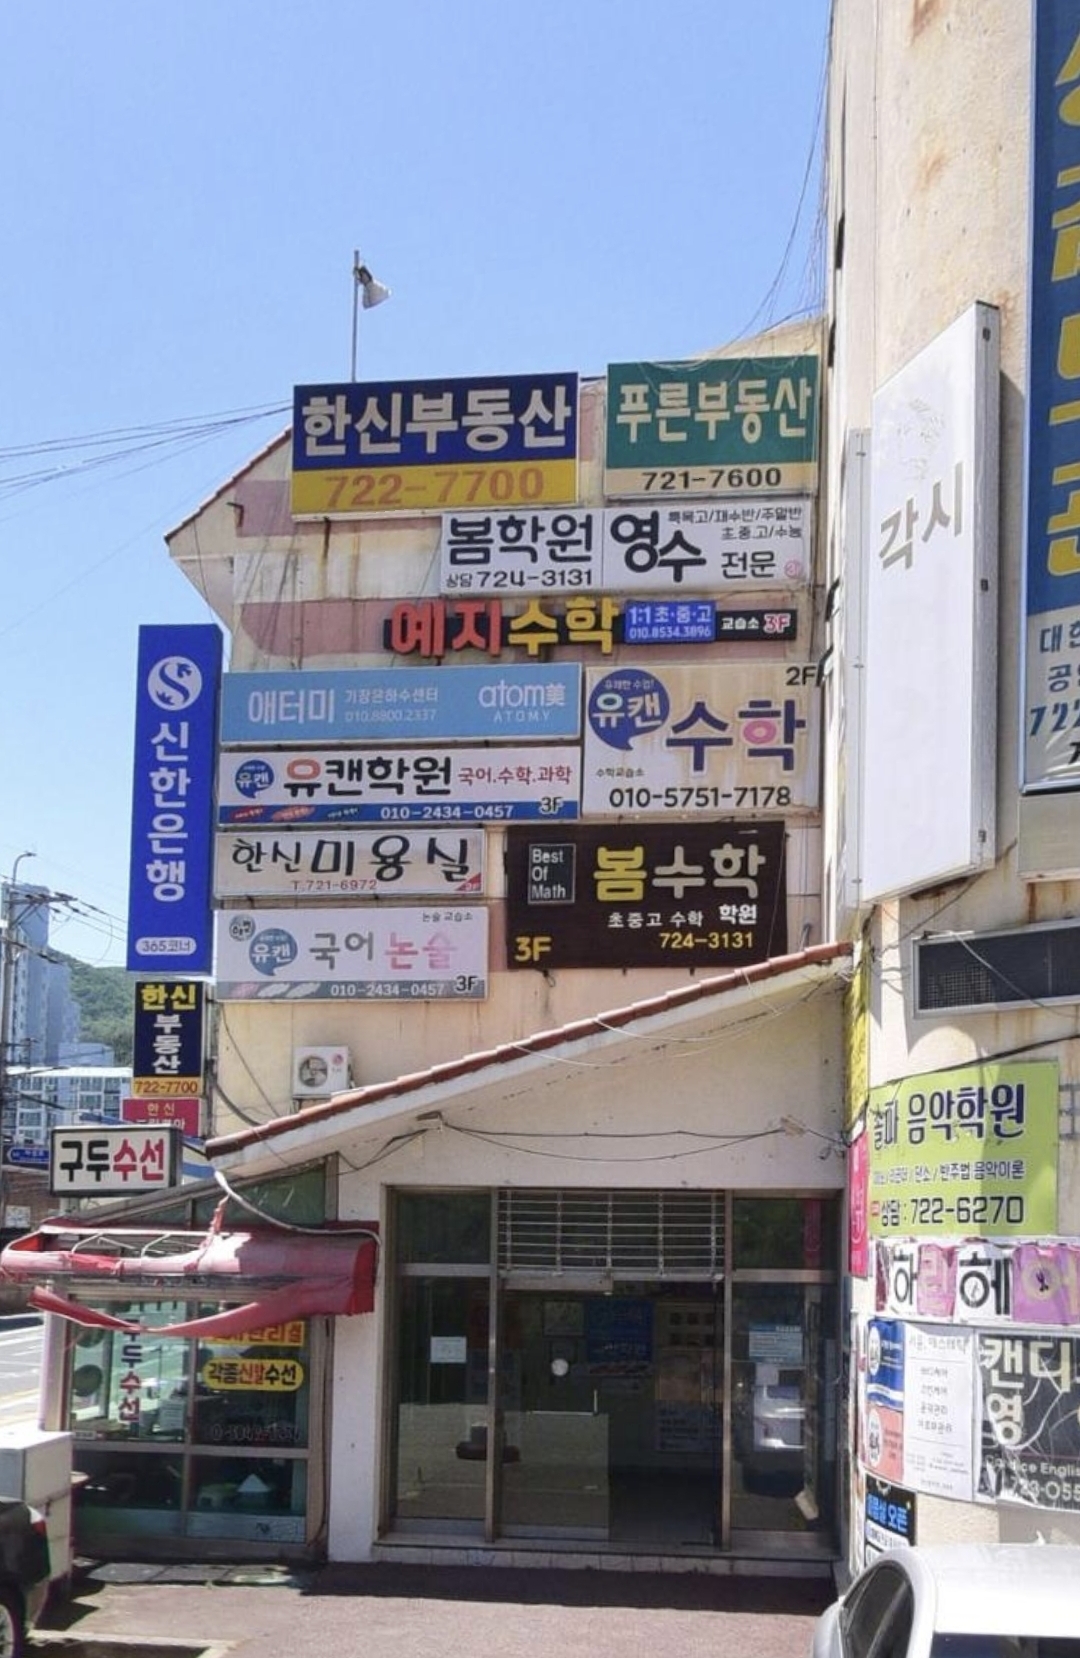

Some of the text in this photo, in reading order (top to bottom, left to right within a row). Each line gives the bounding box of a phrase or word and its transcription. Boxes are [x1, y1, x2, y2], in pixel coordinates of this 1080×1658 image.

[302, 383, 571, 458] 한신부동산
[616, 377, 812, 444] 푸른부동산
[325, 468, 544, 507] 722-7700
[642, 467, 782, 491] 721-7600
[879, 461, 964, 570] 각시
[447, 512, 593, 565] 봄학원
[610, 510, 707, 583] 영수
[721, 551, 776, 579] 전문
[446, 568, 593, 589] 상담 724-3131
[391, 598, 618, 657] 예지수학
[628, 606, 651, 625] 1:1
[721, 613, 792, 634] 교습소 3F
[786, 666, 817, 686] 2F
[249, 688, 335, 725] 애터미
[493, 710, 550, 723] ATOMY
[591, 692, 663, 729] 유캔
[665, 699, 806, 772] 수학
[283, 756, 451, 799] 유캔학원
[458, 765, 573, 786] 국어.수학.과학
[538, 797, 563, 815] 3F
[609, 785, 792, 808] 010-5751-7178
[146, 720, 192, 902] 신한은행
[380, 805, 514, 821] 010-2434-0457
[531, 849, 565, 864] Best
[531, 866, 549, 882] Of
[593, 843, 766, 901] 봄수학
[293, 879, 379, 891] T.721-6972
[531, 883, 566, 899] Math
[669, 911, 704, 927] 수학
[718, 904, 758, 925] 학원
[141, 940, 192, 954] 365코너
[309, 929, 458, 971] 국어 논술
[514, 936, 552, 961] 3F
[659, 931, 754, 949] 724-3131
[251, 943, 292, 963] 유캔
[330, 984, 444, 997] 010-2434-0457
[454, 975, 478, 992] 3F
[141, 984, 197, 1012] 한신
[153, 1013, 183, 1075] 부동산
[134, 1080, 198, 1094] 722-7700
[907, 1083, 1026, 1145] 음악학원
[60, 1138, 165, 1182] 구두수선
[910, 1195, 1025, 1225] 722-6270
